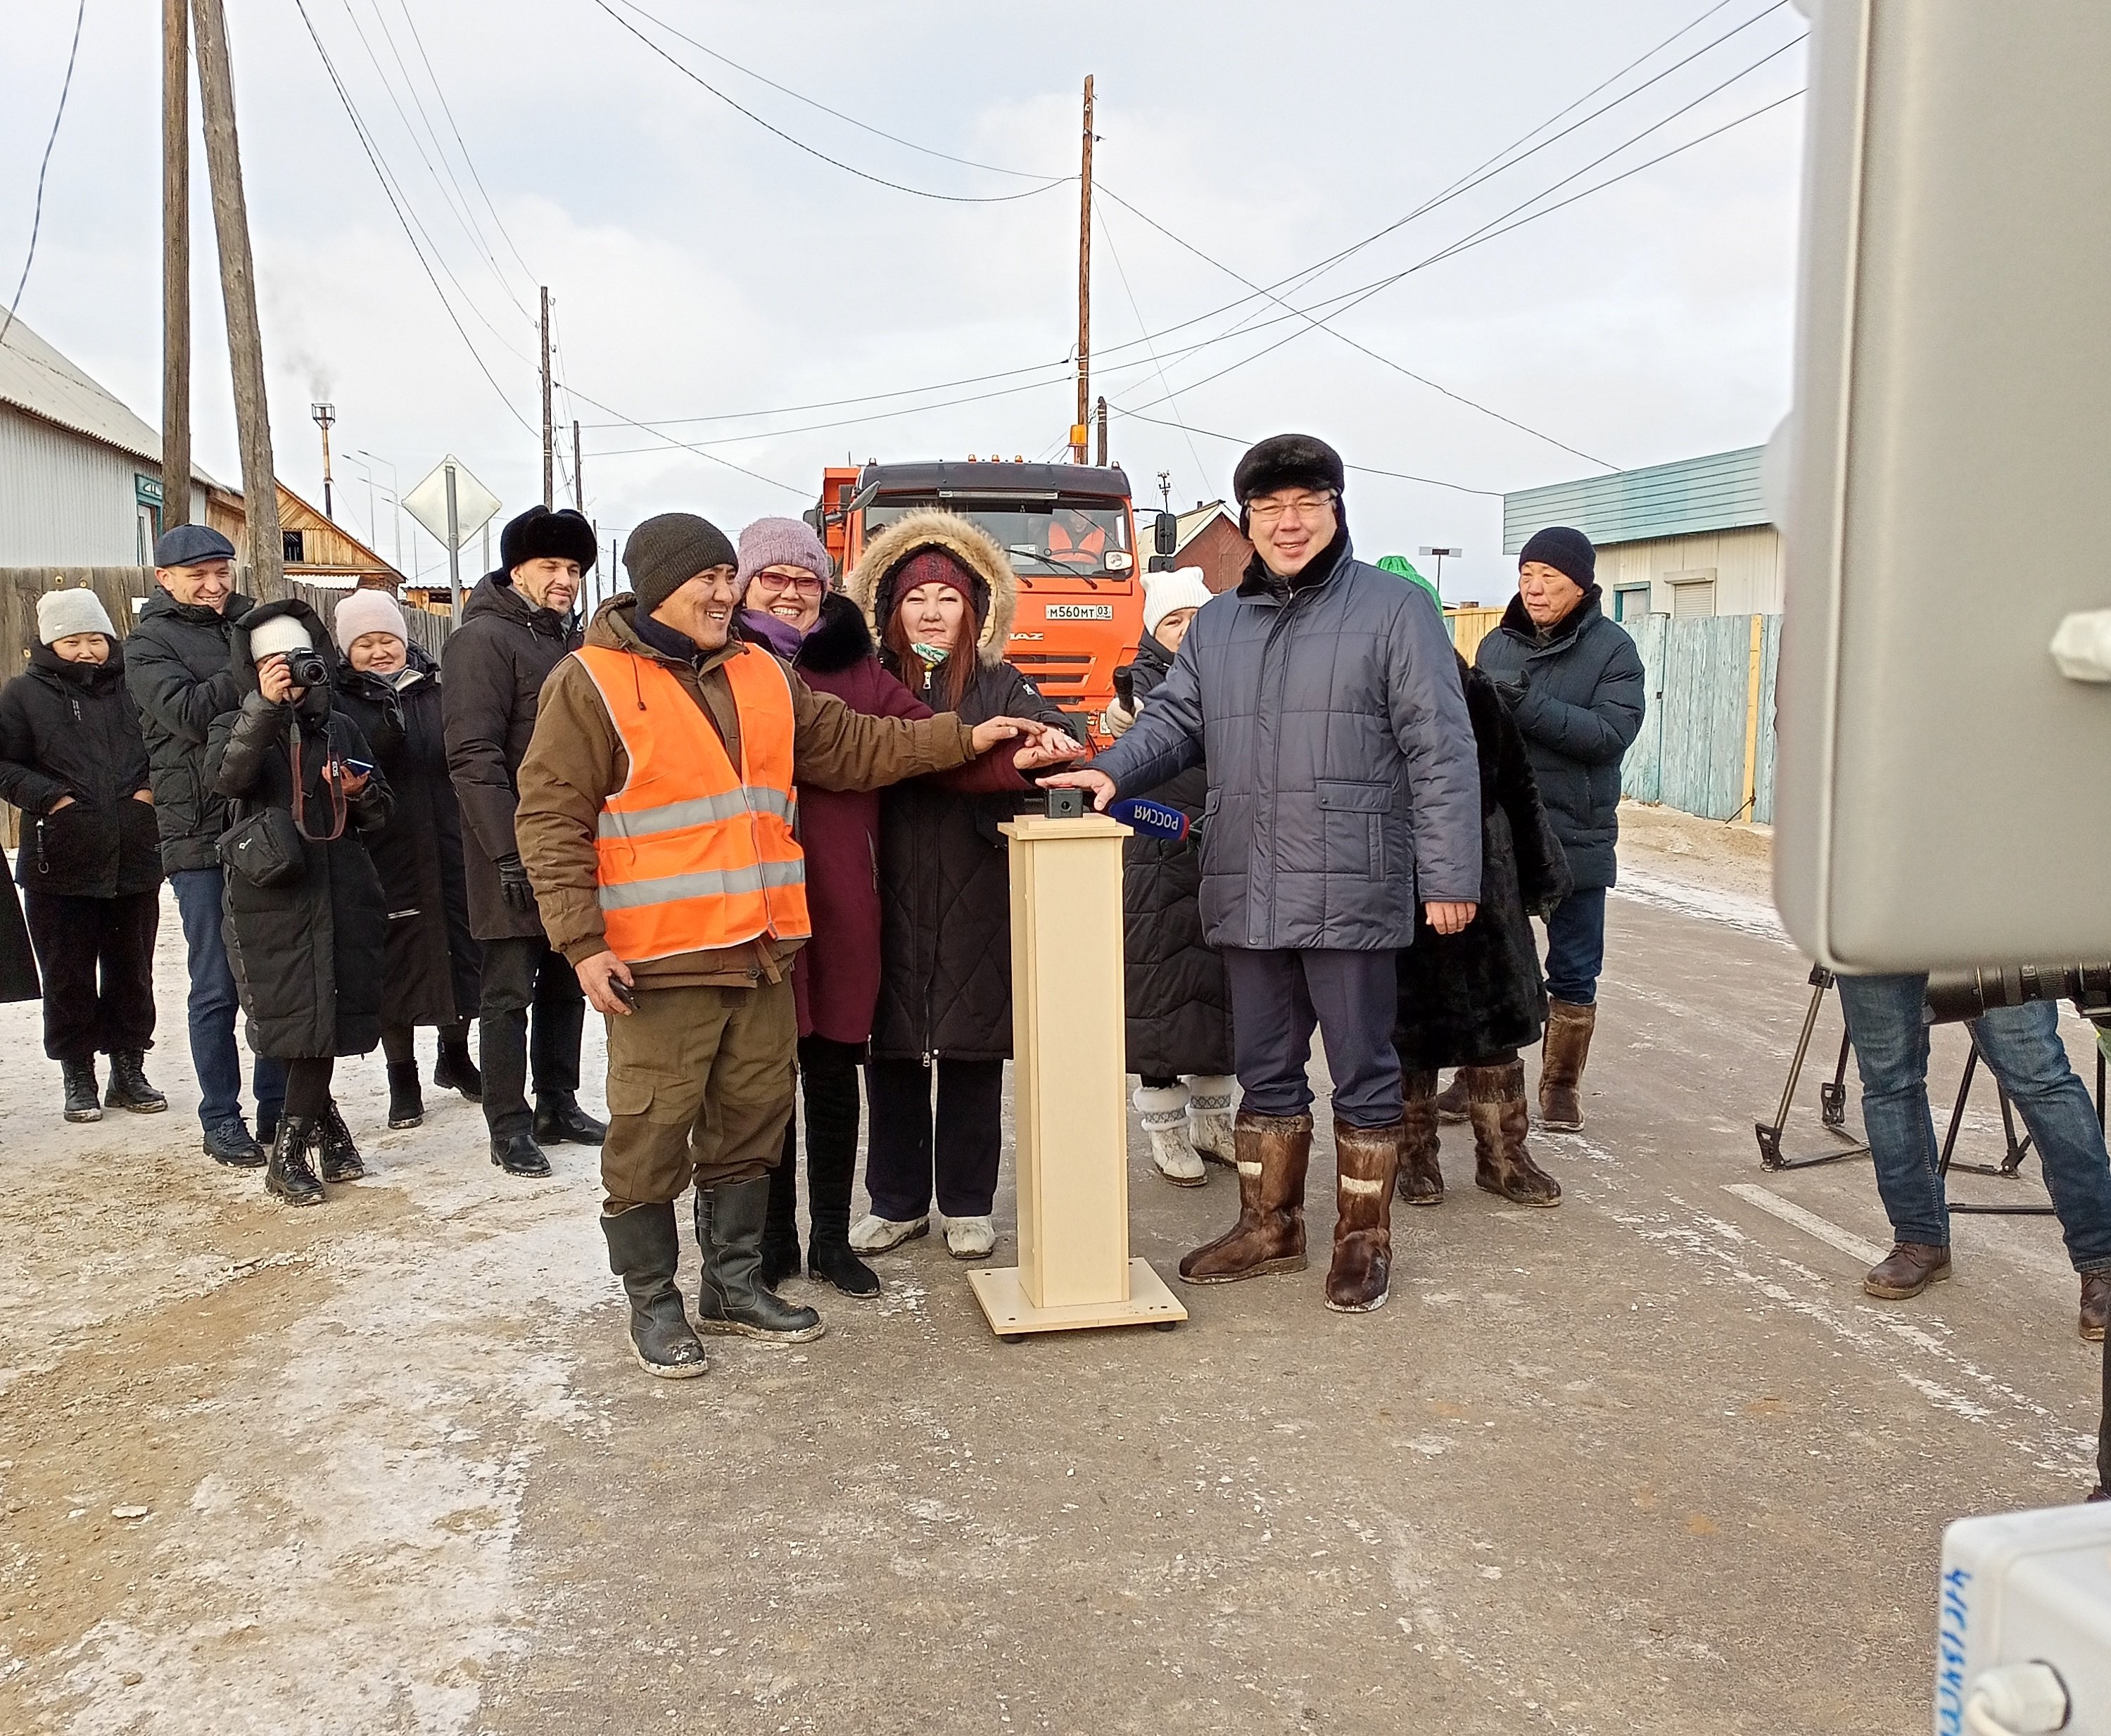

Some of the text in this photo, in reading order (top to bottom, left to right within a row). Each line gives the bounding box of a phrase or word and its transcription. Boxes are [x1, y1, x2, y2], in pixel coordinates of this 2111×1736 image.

[1050, 607, 1108, 618] М560МТ 03
[1134, 804, 1179, 831] РОССИЯ
